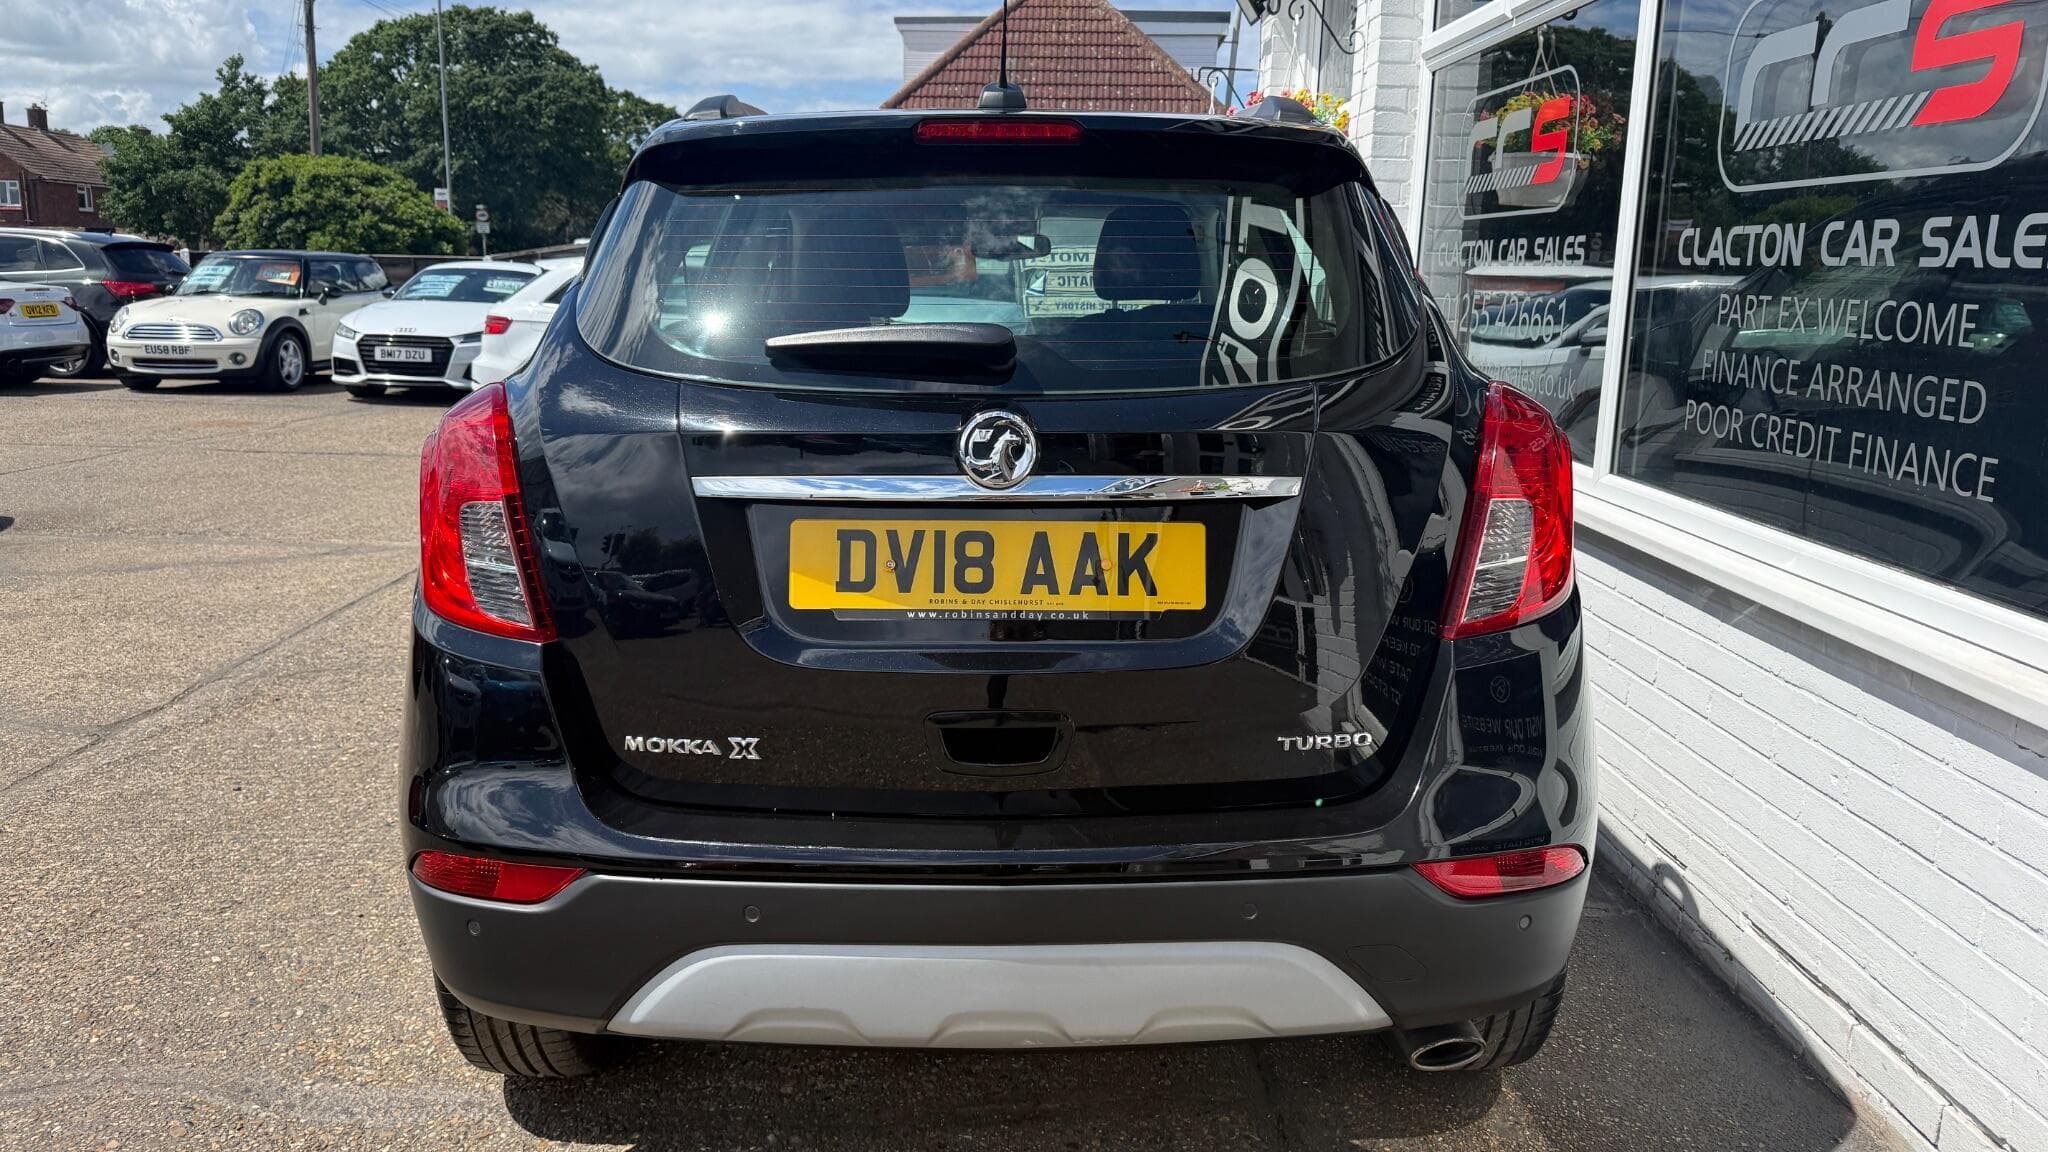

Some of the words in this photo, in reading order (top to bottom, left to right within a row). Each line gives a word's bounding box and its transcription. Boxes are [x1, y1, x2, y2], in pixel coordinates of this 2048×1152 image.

[1438, 239, 1493, 268] CLACTON
[1498, 237, 1528, 266] CAR
[1533, 234, 1587, 267] SALES
[1678, 222, 1806, 267] CLACTON
[1820, 218, 1900, 267] CAR
[1919, 212, 2048, 269] SALE
[1495, 291, 1570, 342] 426661
[1716, 293, 1772, 330] PART
[1777, 295, 1811, 334] EX
[1816, 297, 1979, 349] WELCOME
[144, 344, 170, 354] EU58
[171, 344, 191, 355] RBF
[380, 349, 402, 360] BM17
[405, 349, 426, 360] DZU
[1701, 349, 1802, 396] FINANCE
[1806, 362, 1987, 425] ARRANGED
[1684, 398, 1743, 444] POOR
[1750, 411, 1843, 464] CREDIT
[1848, 431, 1999, 503] FINANCE
[836, 528, 995, 595] DV18
[1020, 531, 1159, 598] AAK
[907, 610, 1090, 622] www.robinsandday.co.uk
[625, 735, 722, 756] MOKKA
[728, 736, 762, 760] X
[1277, 731, 1373, 752] TURBO
